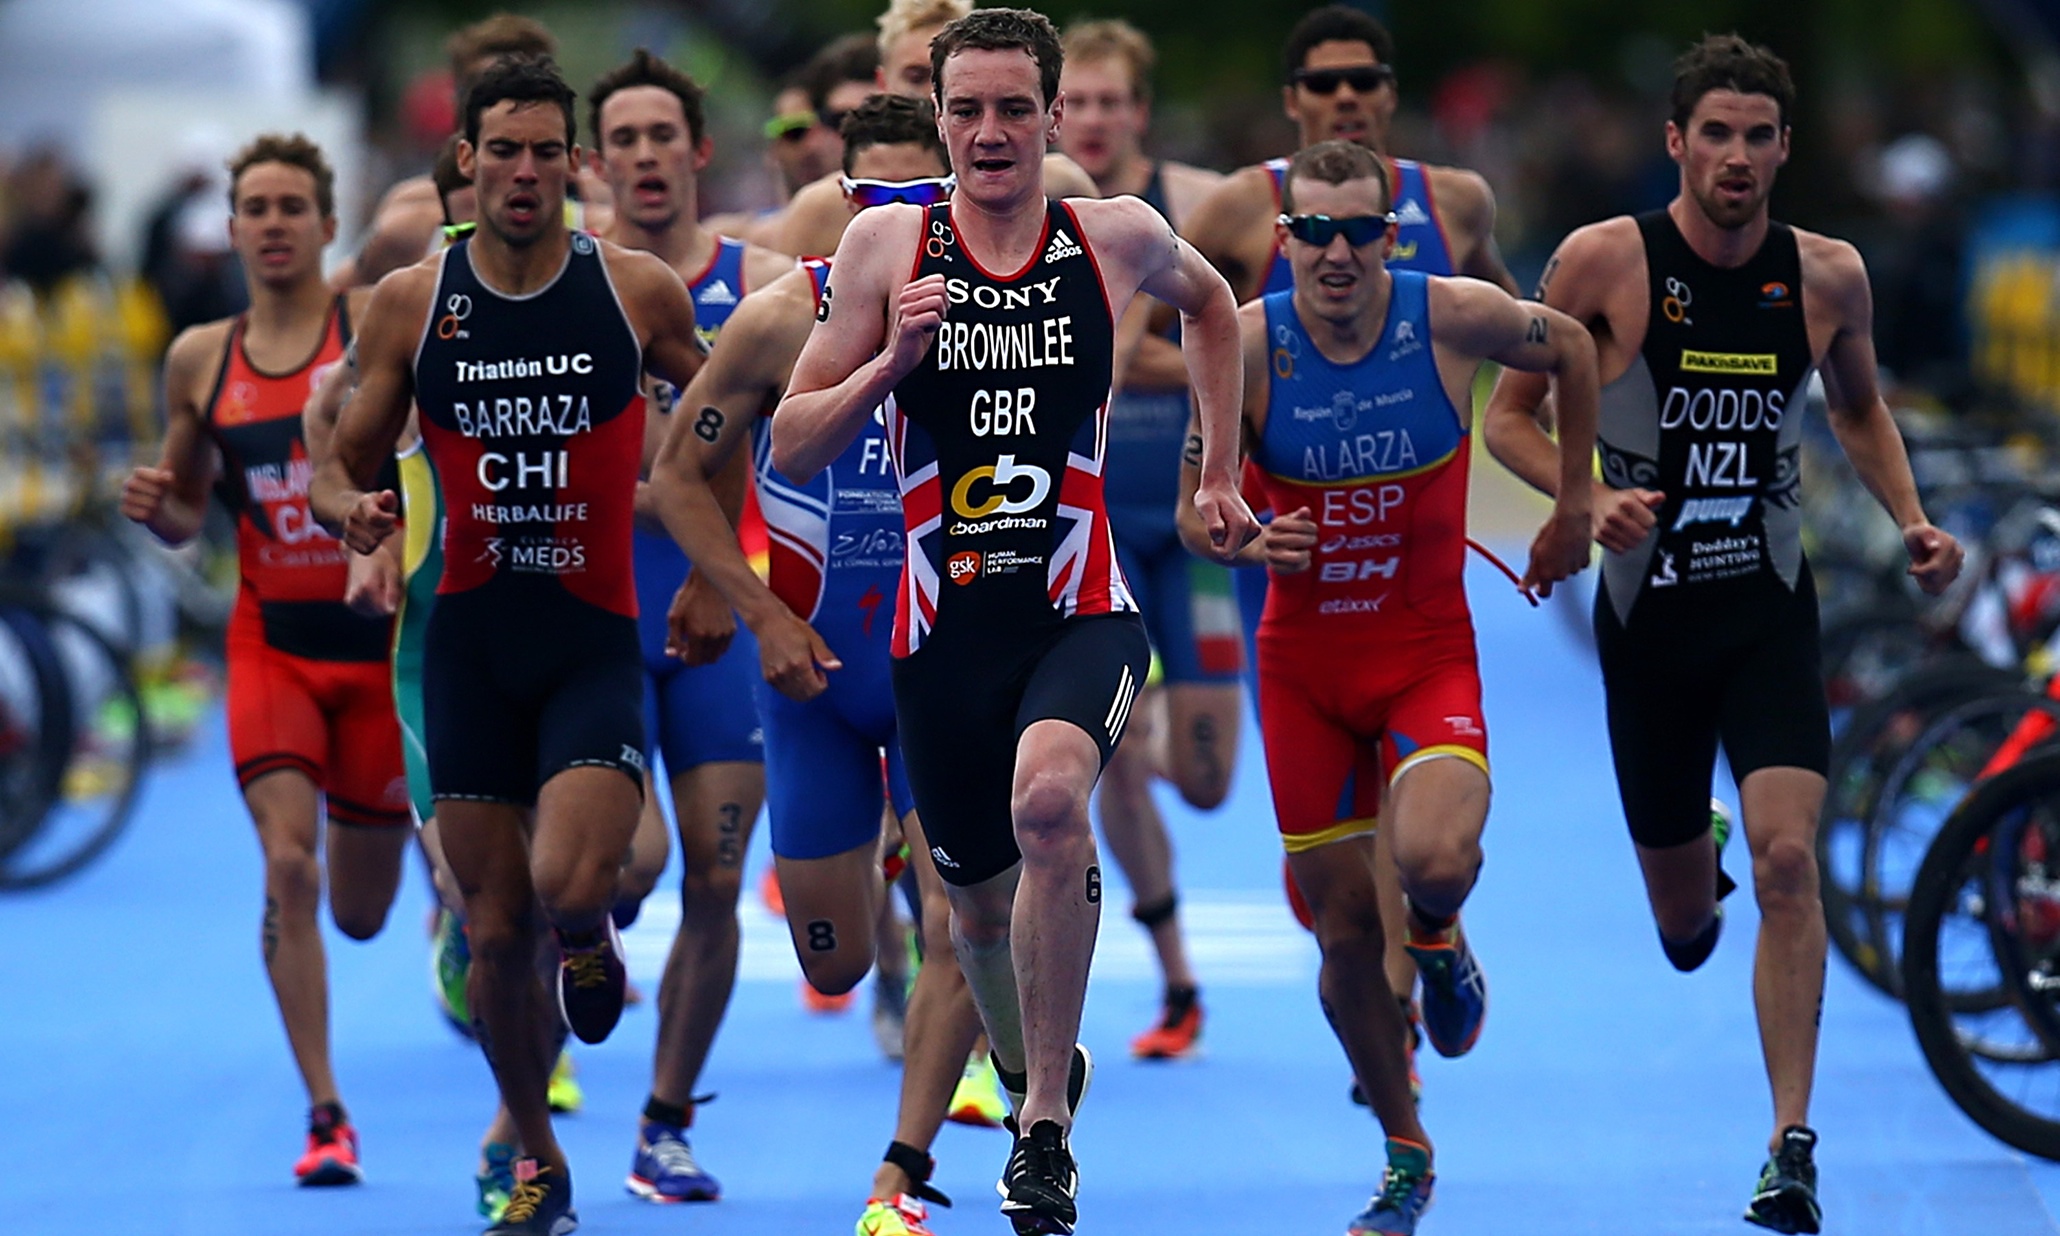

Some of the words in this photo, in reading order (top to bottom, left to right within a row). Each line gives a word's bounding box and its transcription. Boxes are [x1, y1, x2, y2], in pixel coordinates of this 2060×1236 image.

[1045, 245, 1082, 263] adidas
[946, 276, 1062, 309] SONY
[938, 316, 1075, 371] BROWNLEE
[455, 357, 543, 382] Triatlón
[546, 353, 594, 375] UC
[454, 394, 591, 437] BARRAZA
[694, 406, 725, 442] 8
[970, 387, 1037, 437] GBR
[1660, 386, 1785, 431] DODDS
[477, 450, 568, 492] CHI
[1303, 427, 1418, 480] ALARZA
[1684, 442, 1759, 487] NZL
[471, 503, 588, 524] HERBALIFE
[1322, 484, 1405, 527] ESP
[512, 545, 586, 568] MEDS
[950, 556, 977, 579] gsk
[1320, 556, 1400, 582] BH
[808, 919, 838, 952] 8
